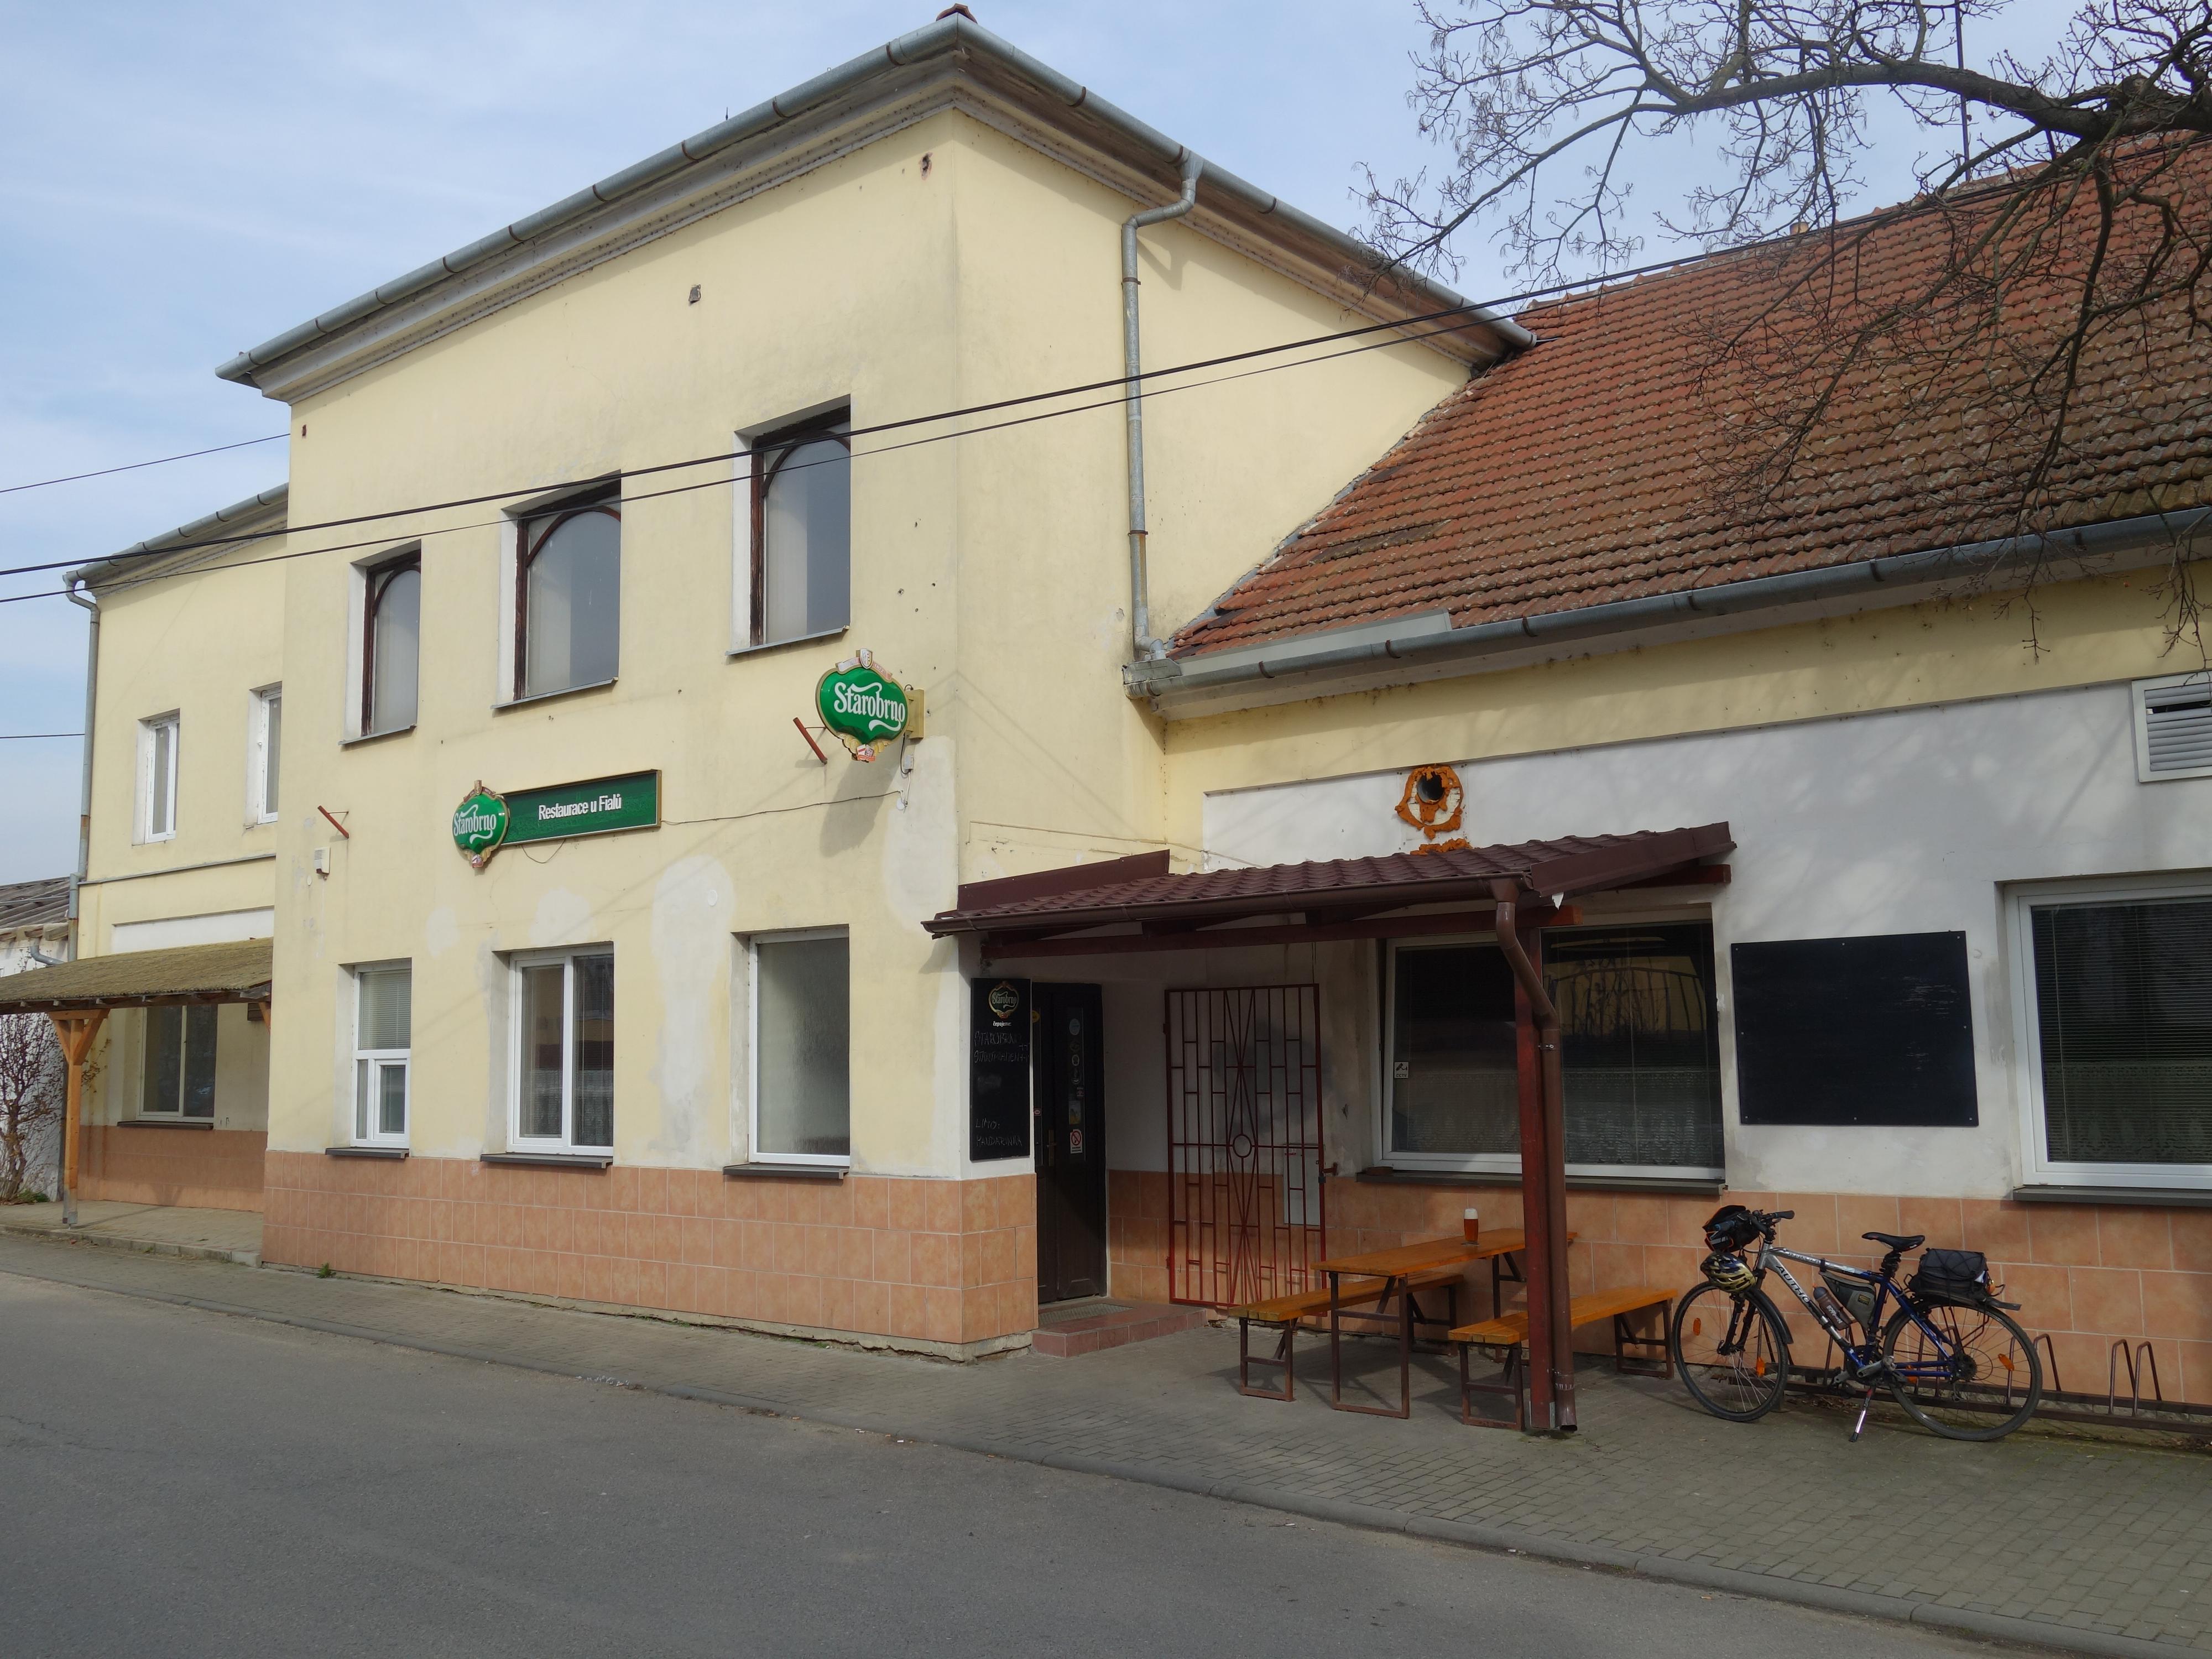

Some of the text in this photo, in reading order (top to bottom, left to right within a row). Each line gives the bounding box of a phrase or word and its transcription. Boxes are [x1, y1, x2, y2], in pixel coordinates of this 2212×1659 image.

[834, 682, 906, 732] Starobrno
[453, 804, 497, 844] Starobrno
[538, 794, 622, 821] Restaurace u Fialů
[992, 991, 1017, 1009] Starobrno
[1776, 1265, 1812, 1304] AUTHO
